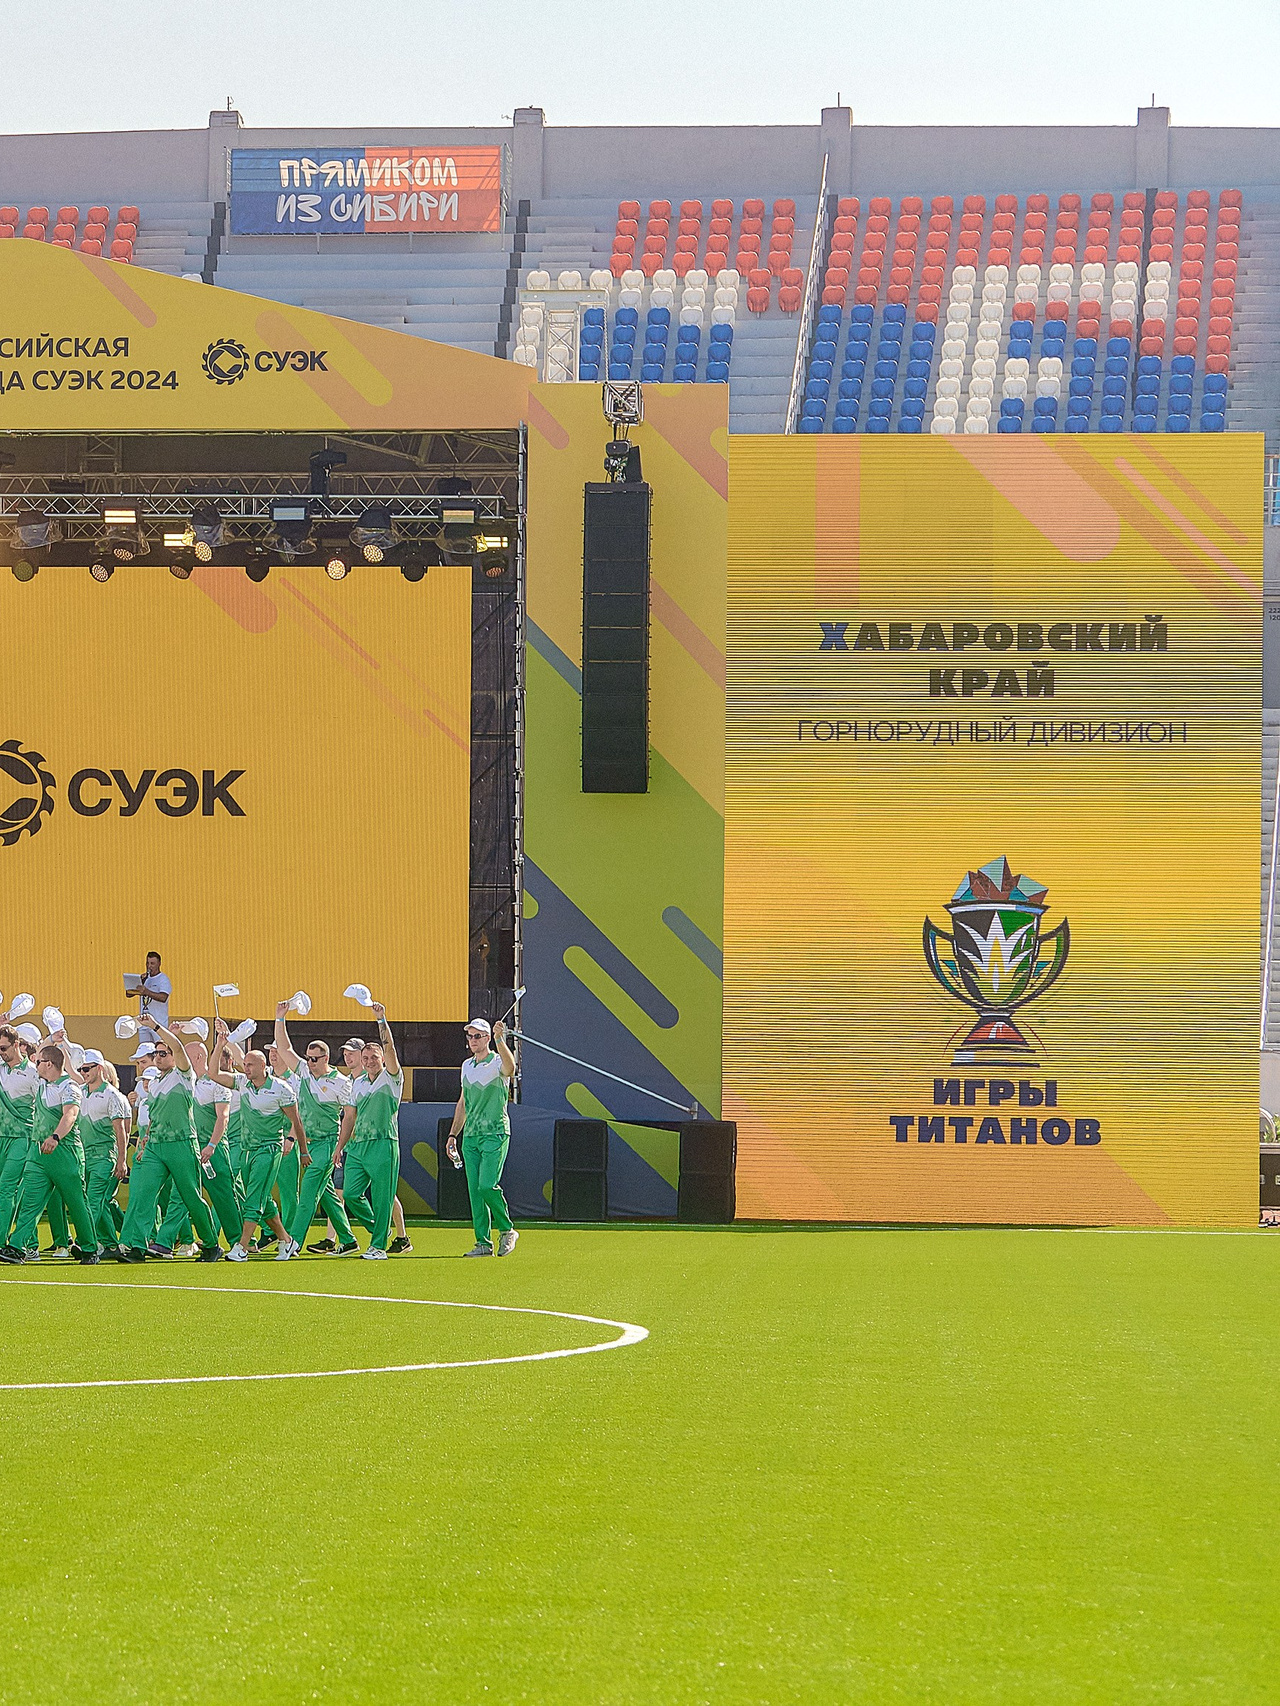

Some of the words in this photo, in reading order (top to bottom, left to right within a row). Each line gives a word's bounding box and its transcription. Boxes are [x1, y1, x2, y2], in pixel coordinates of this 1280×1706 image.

[278, 157, 459, 188] ПРЯМИКОМ
[276, 194, 322, 223] ИЗ
[329, 191, 459, 223] СИБИРИ
[253, 350, 329, 372] СУЭК
[31, 370, 104, 390] СУЭК
[110, 370, 179, 390] 2024
[819, 614, 1169, 652] ХАБАРОВСКИЙ
[929, 660, 1056, 697] КРАЙ
[797, 715, 1017, 747] ГОРНОРУДНЫЙ
[1027, 719, 1188, 747] ДИВИЗИОН
[67, 767, 248, 818] СУЭК
[933, 1078, 1058, 1107] ИГРЫ
[889, 1116, 1102, 1146] ТИТАНОВ
